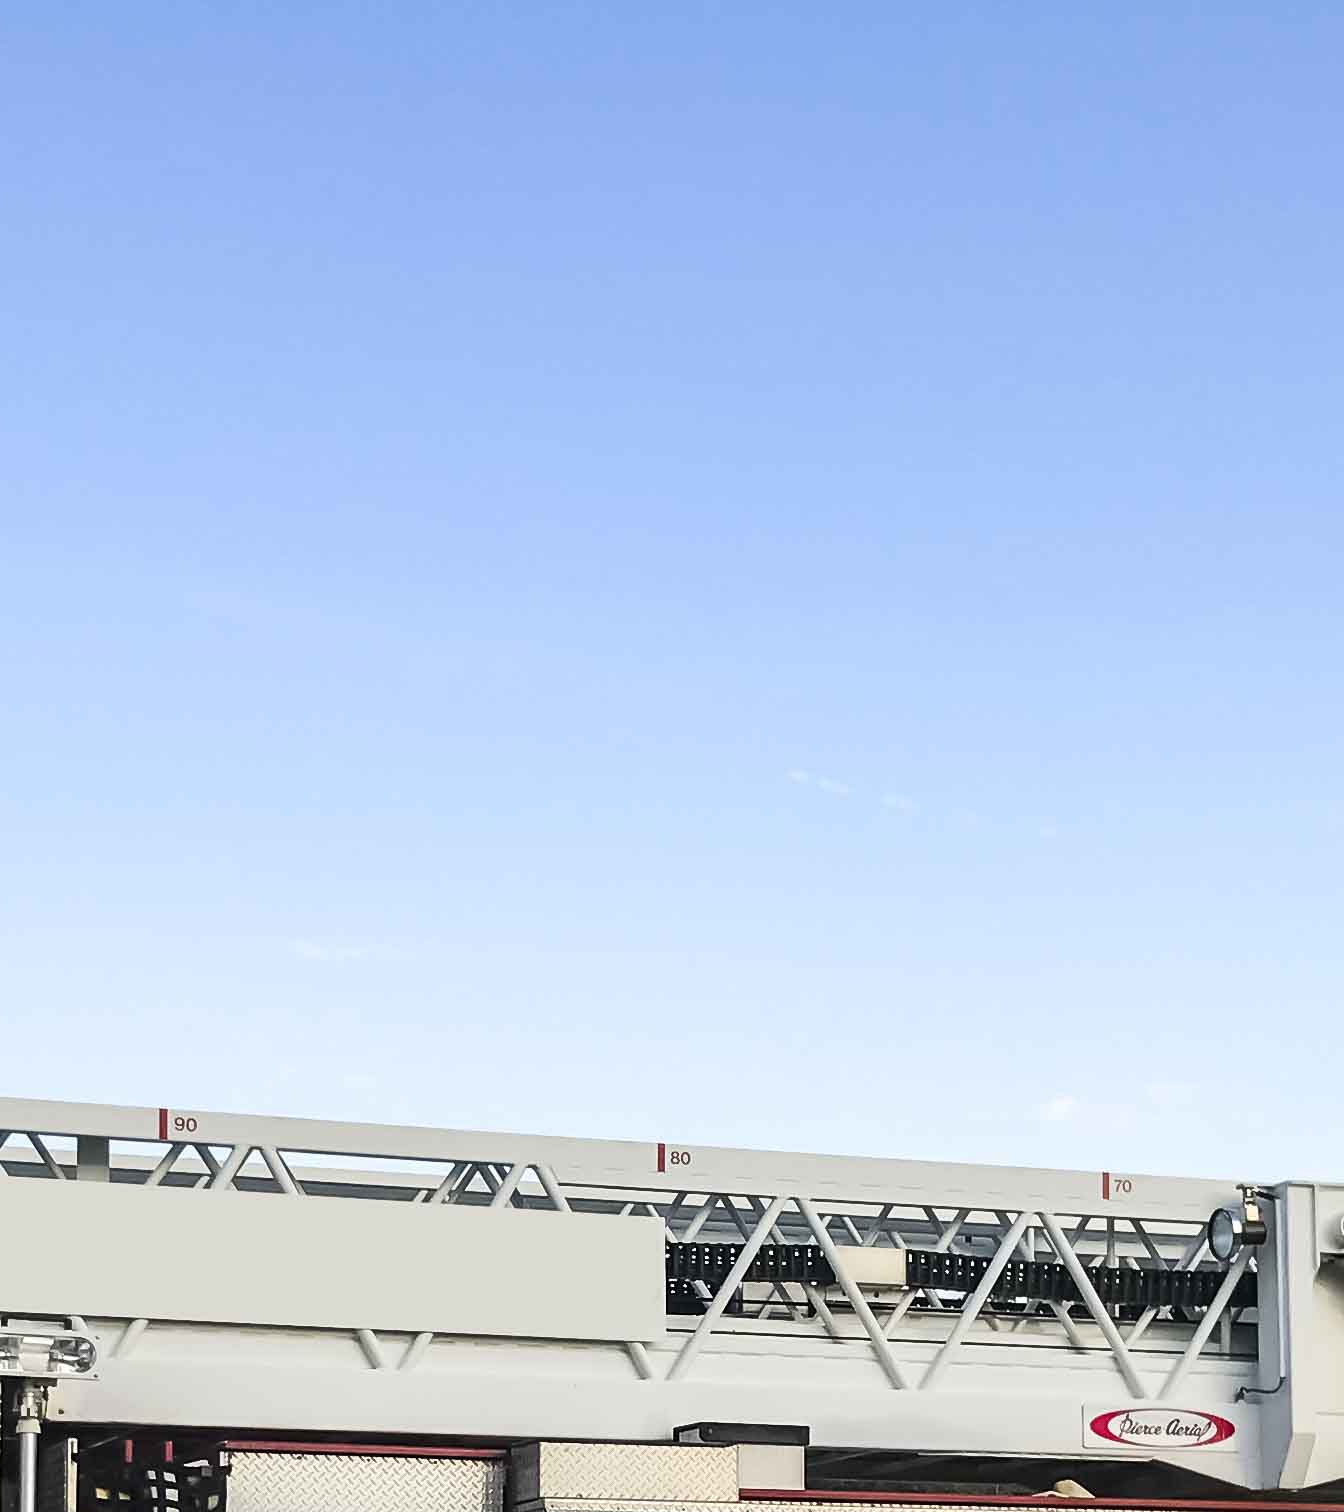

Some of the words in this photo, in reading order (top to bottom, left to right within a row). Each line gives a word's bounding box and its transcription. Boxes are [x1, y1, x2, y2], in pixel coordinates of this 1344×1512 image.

[174, 1116, 198, 1132] 90
[670, 1150, 692, 1166] 80
[1114, 1179, 1132, 1193] 70
[1119, 1411, 1162, 1438] Pierce
[1165, 1418, 1212, 1442] Aerial
